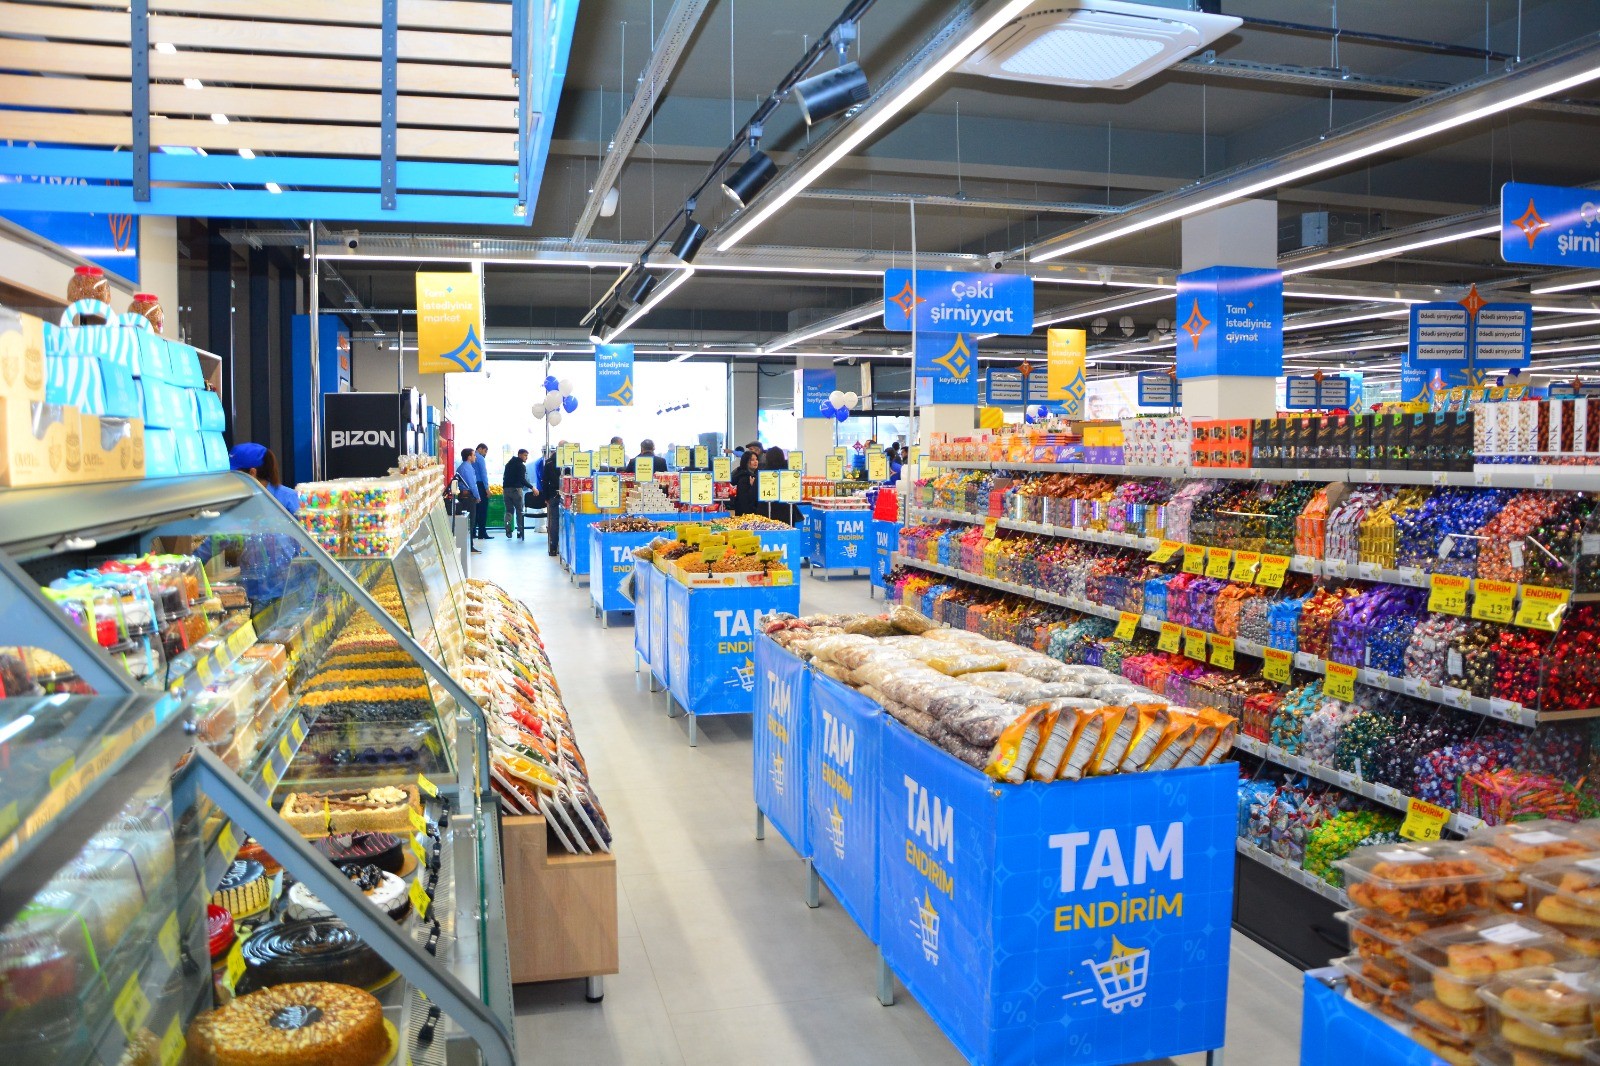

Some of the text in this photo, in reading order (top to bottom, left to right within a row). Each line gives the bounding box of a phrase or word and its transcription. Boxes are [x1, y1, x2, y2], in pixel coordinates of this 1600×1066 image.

[1581, 202, 1600, 228] Ç
[951, 281, 993, 301] Çəki
[424, 314, 461, 322] market
[930, 303, 1014, 326] şirniyyat
[1226, 305, 1246, 315] Tam
[1226, 319, 1272, 330] istədiyiniz
[1226, 331, 1259, 344] qiymət
[331, 430, 396, 448] BIZON
[1486, 426, 1494, 452] PINK
[1508, 426, 1517, 452] PINK
[1530, 425, 1538, 452] PINK
[1550, 424, 1558, 452] PINK
[1574, 424, 1584, 452] PINK
[836, 520, 864, 533] TAM
[610, 546, 634, 562] TA
[762, 544, 788, 560] AM
[1434, 577, 1464, 587] ENDİRİM
[1478, 582, 1511, 593] ENDİRİM
[1526, 588, 1562, 600] ENDİRİM
[1490, 604, 1502, 614] 13
[767, 670, 791, 723] TAM
[822, 710, 854, 775] TAM
[904, 774, 954, 864] TAM
[1412, 802, 1444, 820] ENDİRİM
[1424, 828, 1431, 838] 9
[1048, 822, 1184, 892] TAM
[906, 838, 954, 900] ENDİRİM
[1054, 888, 1182, 931] ENDİRİM
